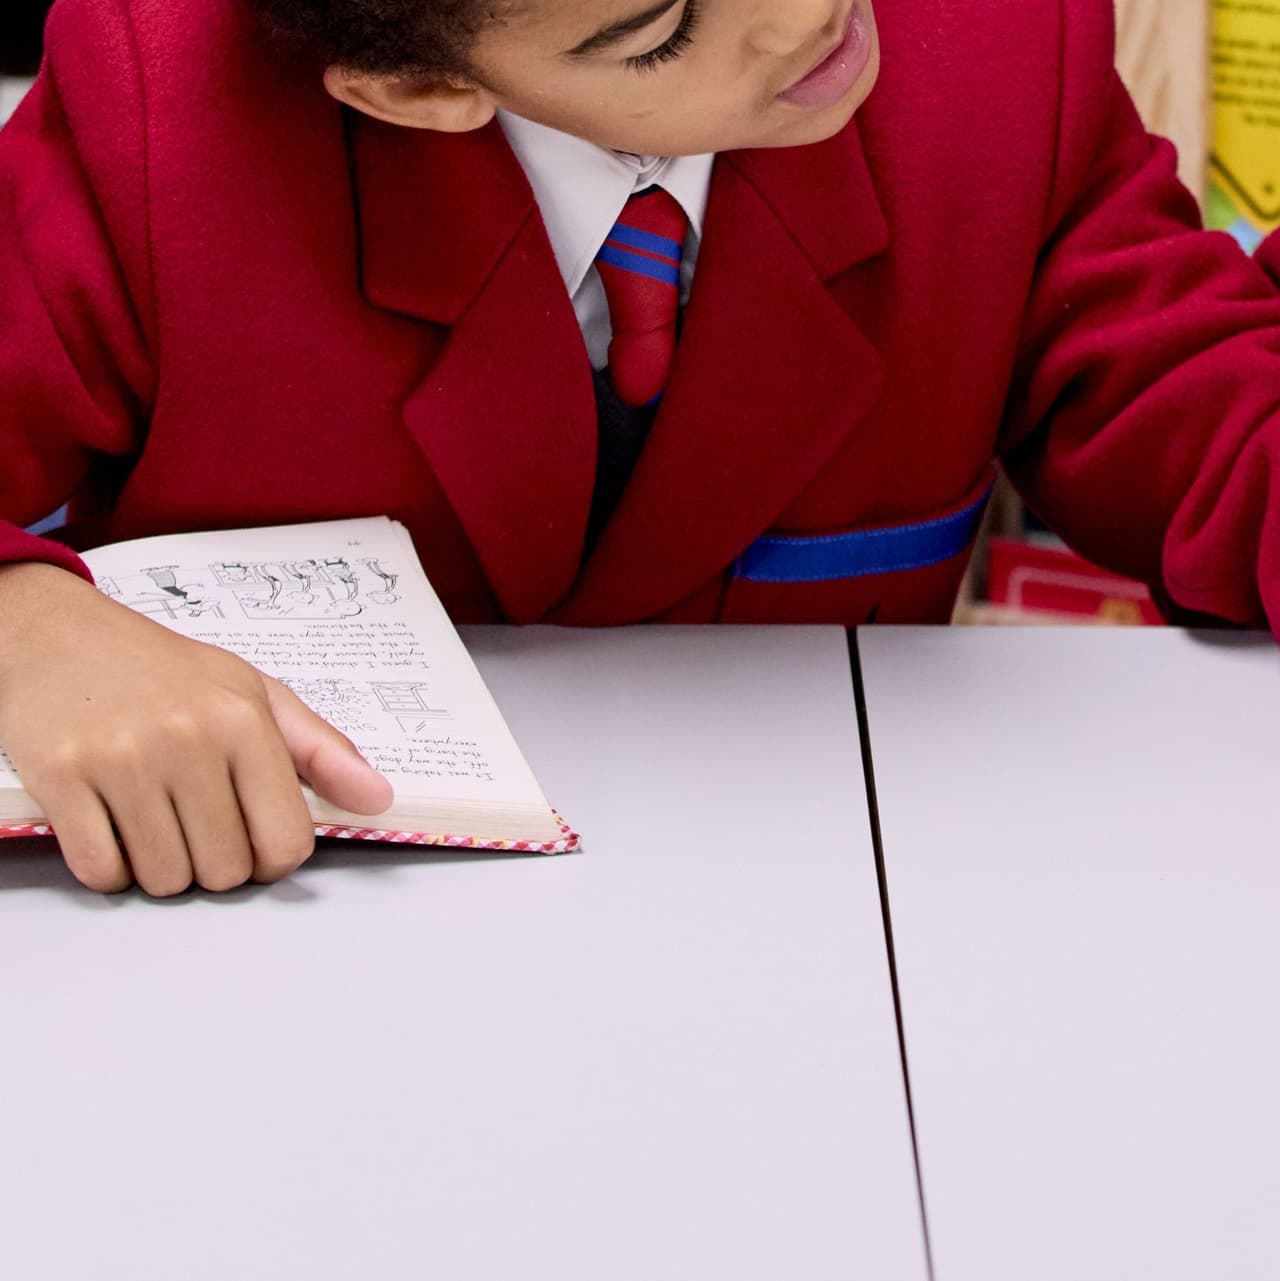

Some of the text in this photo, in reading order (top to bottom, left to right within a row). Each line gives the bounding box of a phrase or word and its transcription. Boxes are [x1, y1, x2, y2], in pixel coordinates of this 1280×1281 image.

[303, 623, 364, 631] bathroom.
[368, 622, 389, 631] the
[266, 632, 296, 640] have
[298, 629, 325, 639] guys
[349, 631, 376, 640] that
[382, 631, 416, 640] house
[306, 641, 336, 649] seat.
[342, 641, 372, 649] toilet
[335, 651, 377, 659] because
[382, 648, 425, 659] myself,
[273, 660, 301, 668] tried
[309, 660, 358, 670] should've
[381, 658, 412, 666] guess
[406, 735, 477, 747] everywhere.
[358, 746, 380, 754] and
[424, 746, 458, 757] hang
[408, 754, 431, 764] way
[462, 751, 481, 759] the
[374, 754, 402, 766] dogs
[376, 763, 396, 773] way
[438, 761, 457, 769] the
[401, 766, 441, 778] taking
[476, 773, 496, 782] It
